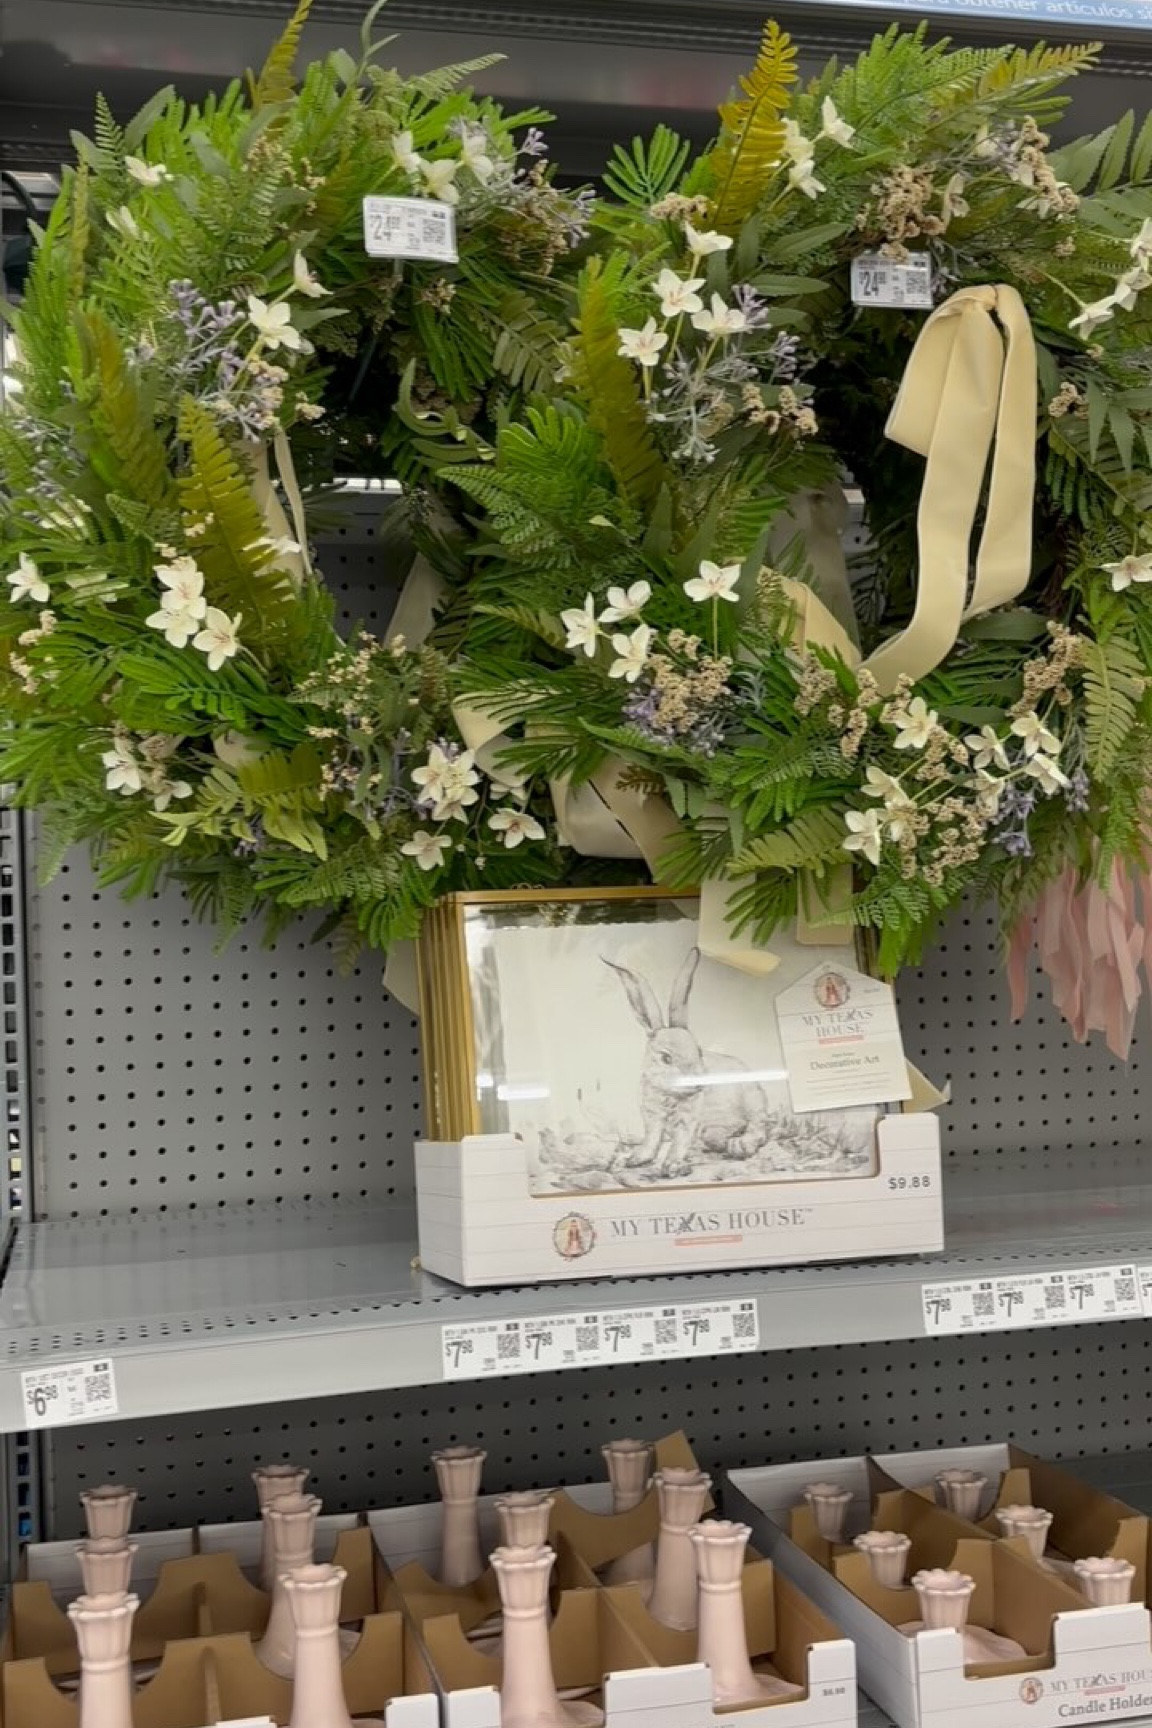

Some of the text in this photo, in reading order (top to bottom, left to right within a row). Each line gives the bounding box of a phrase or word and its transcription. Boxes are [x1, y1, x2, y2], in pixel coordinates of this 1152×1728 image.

[802, 1008, 874, 1026] MY TEXAS
[816, 1024, 865, 1037] HOUSE
[810, 1058, 862, 1071] Decorative
[888, 1175, 931, 1190] $9.88
[611, 1220, 639, 1237] MY
[650, 1212, 720, 1236] TEXAS
[1051, 1668, 1152, 1692] MY TEXAS HOU
[1058, 1694, 1152, 1717] Candle Holde
